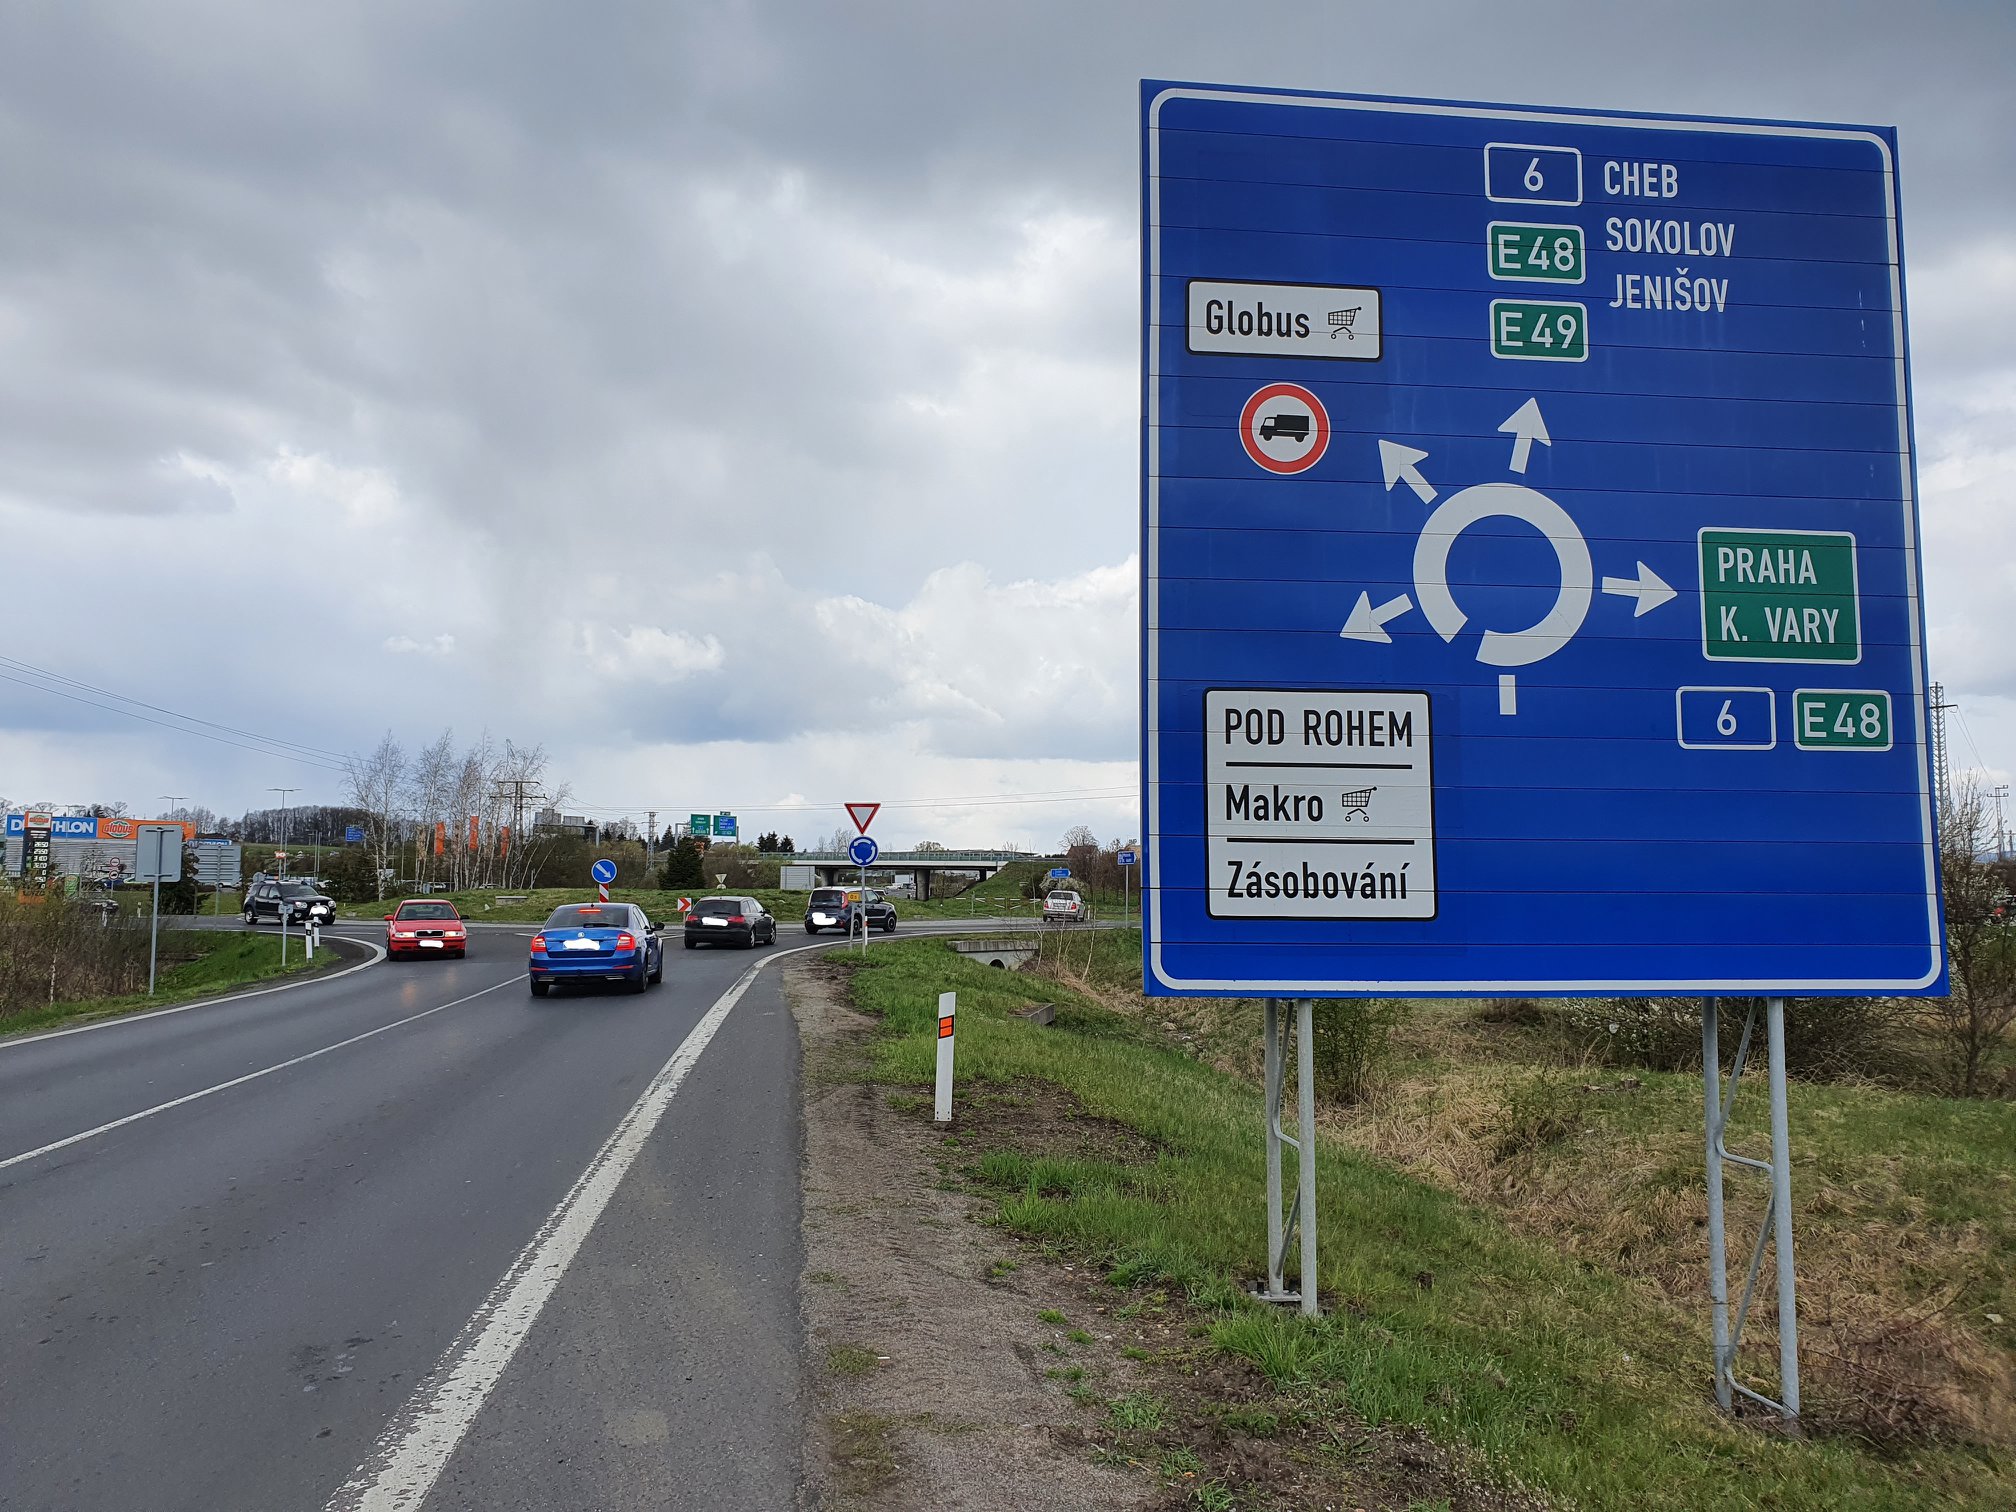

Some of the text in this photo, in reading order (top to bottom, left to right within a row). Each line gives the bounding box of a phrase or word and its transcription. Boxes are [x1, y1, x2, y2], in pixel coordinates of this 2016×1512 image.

[1523, 157, 1544, 192] 6
[1604, 160, 1678, 198] CHEB
[1605, 216, 1735, 257] SOKOLOV
[1608, 267, 1729, 313] JENIŠOV
[1205, 299, 1310, 339] Globus
[1717, 547, 1818, 585] PRAHA
[1720, 605, 1839, 644] K. VARY
[1225, 708, 1413, 748] POD ROHEM
[1716, 699, 1737, 736] 6
[1225, 784, 1324, 822] Makro
[1226, 860, 1411, 900] Zásobování
